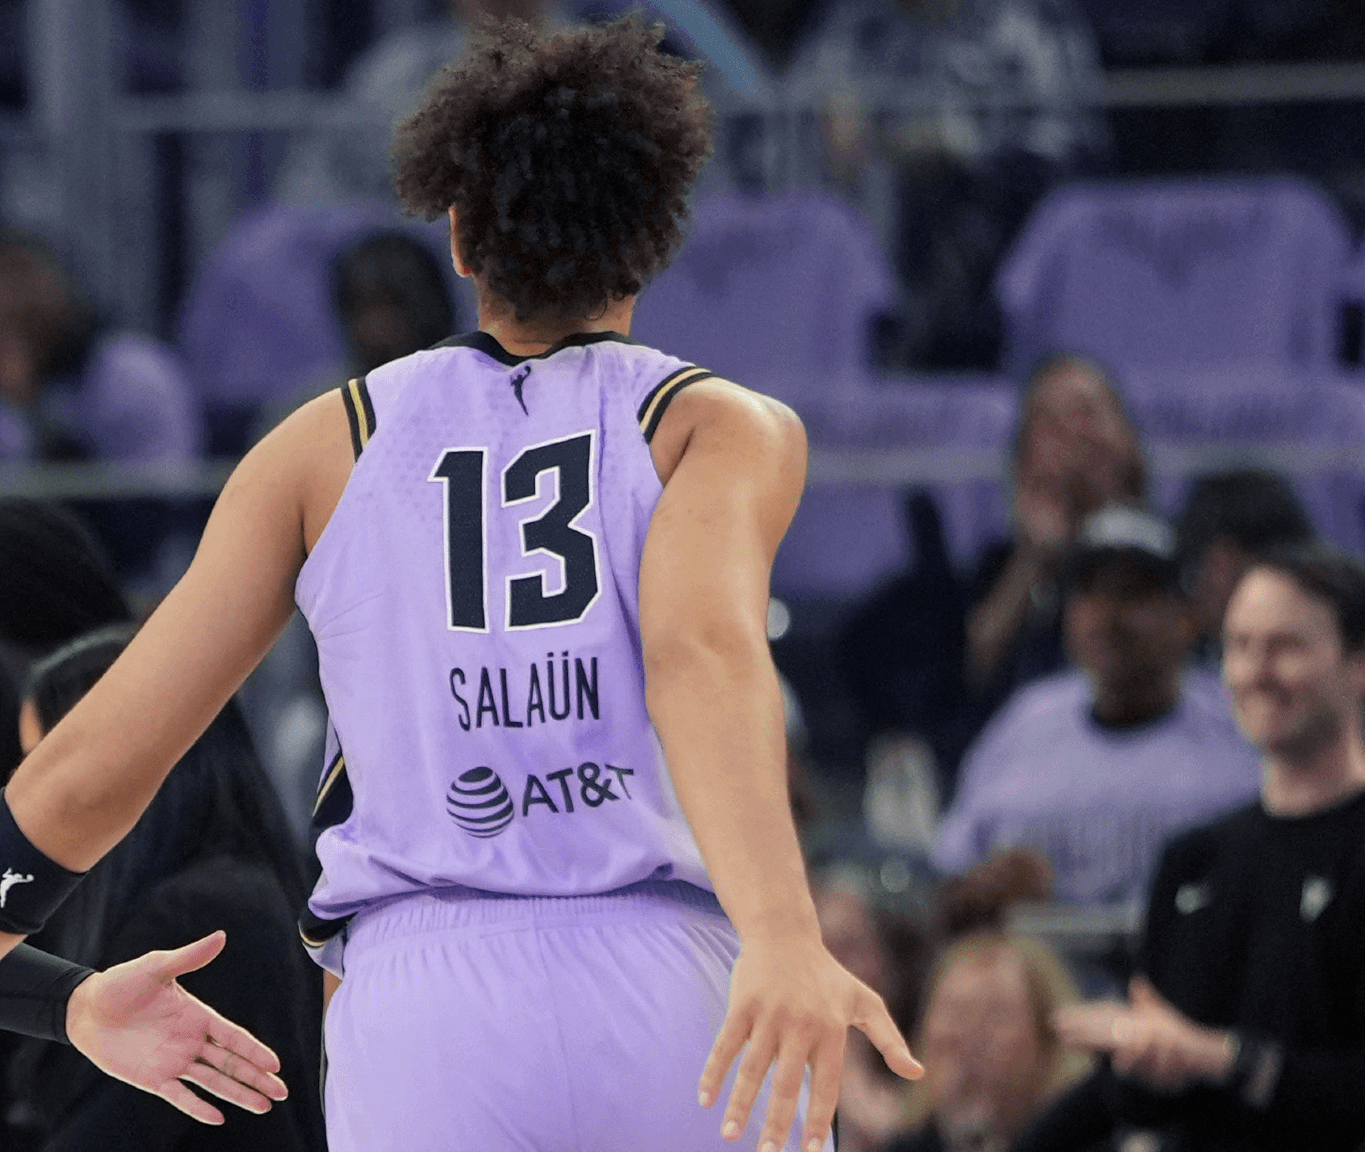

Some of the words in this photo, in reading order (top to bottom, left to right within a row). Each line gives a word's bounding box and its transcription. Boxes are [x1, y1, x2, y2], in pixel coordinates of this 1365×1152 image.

[427, 429, 602, 633] 13
[449, 651, 601, 732] SALAÜN
[521, 762, 635, 817] AT&T
